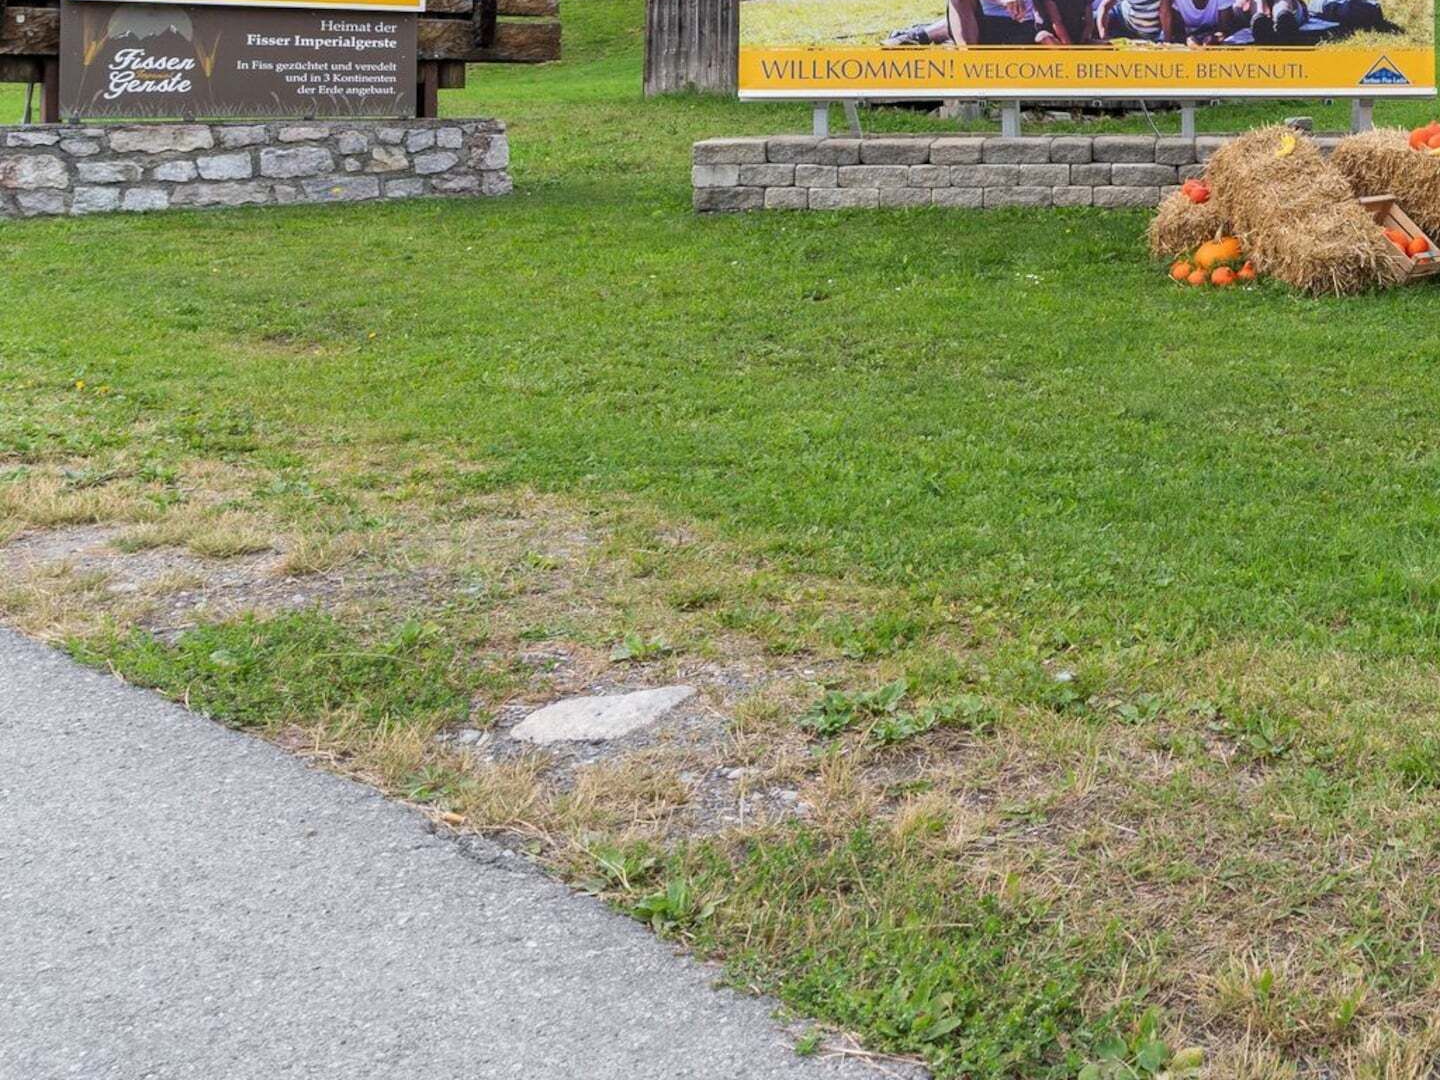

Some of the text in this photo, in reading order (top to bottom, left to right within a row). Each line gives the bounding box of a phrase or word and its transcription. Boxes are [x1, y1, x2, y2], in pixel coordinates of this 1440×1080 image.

[321, 20, 397, 33] Heimat der
[247, 34, 397, 51] Fisser Imperialgerste
[108, 48, 196, 70] Fisser
[237, 60, 397, 73] In Fiss gezüchtet und veredelt
[761, 59, 1309, 80] WILLKOMMEN! WELCOME. BIENVENUE. BENVENUTI.
[103, 70, 192, 100] Gerste
[286, 74, 397, 83] und in 3 Kontinenten
[297, 85, 396, 97] der Erde angebaut.
